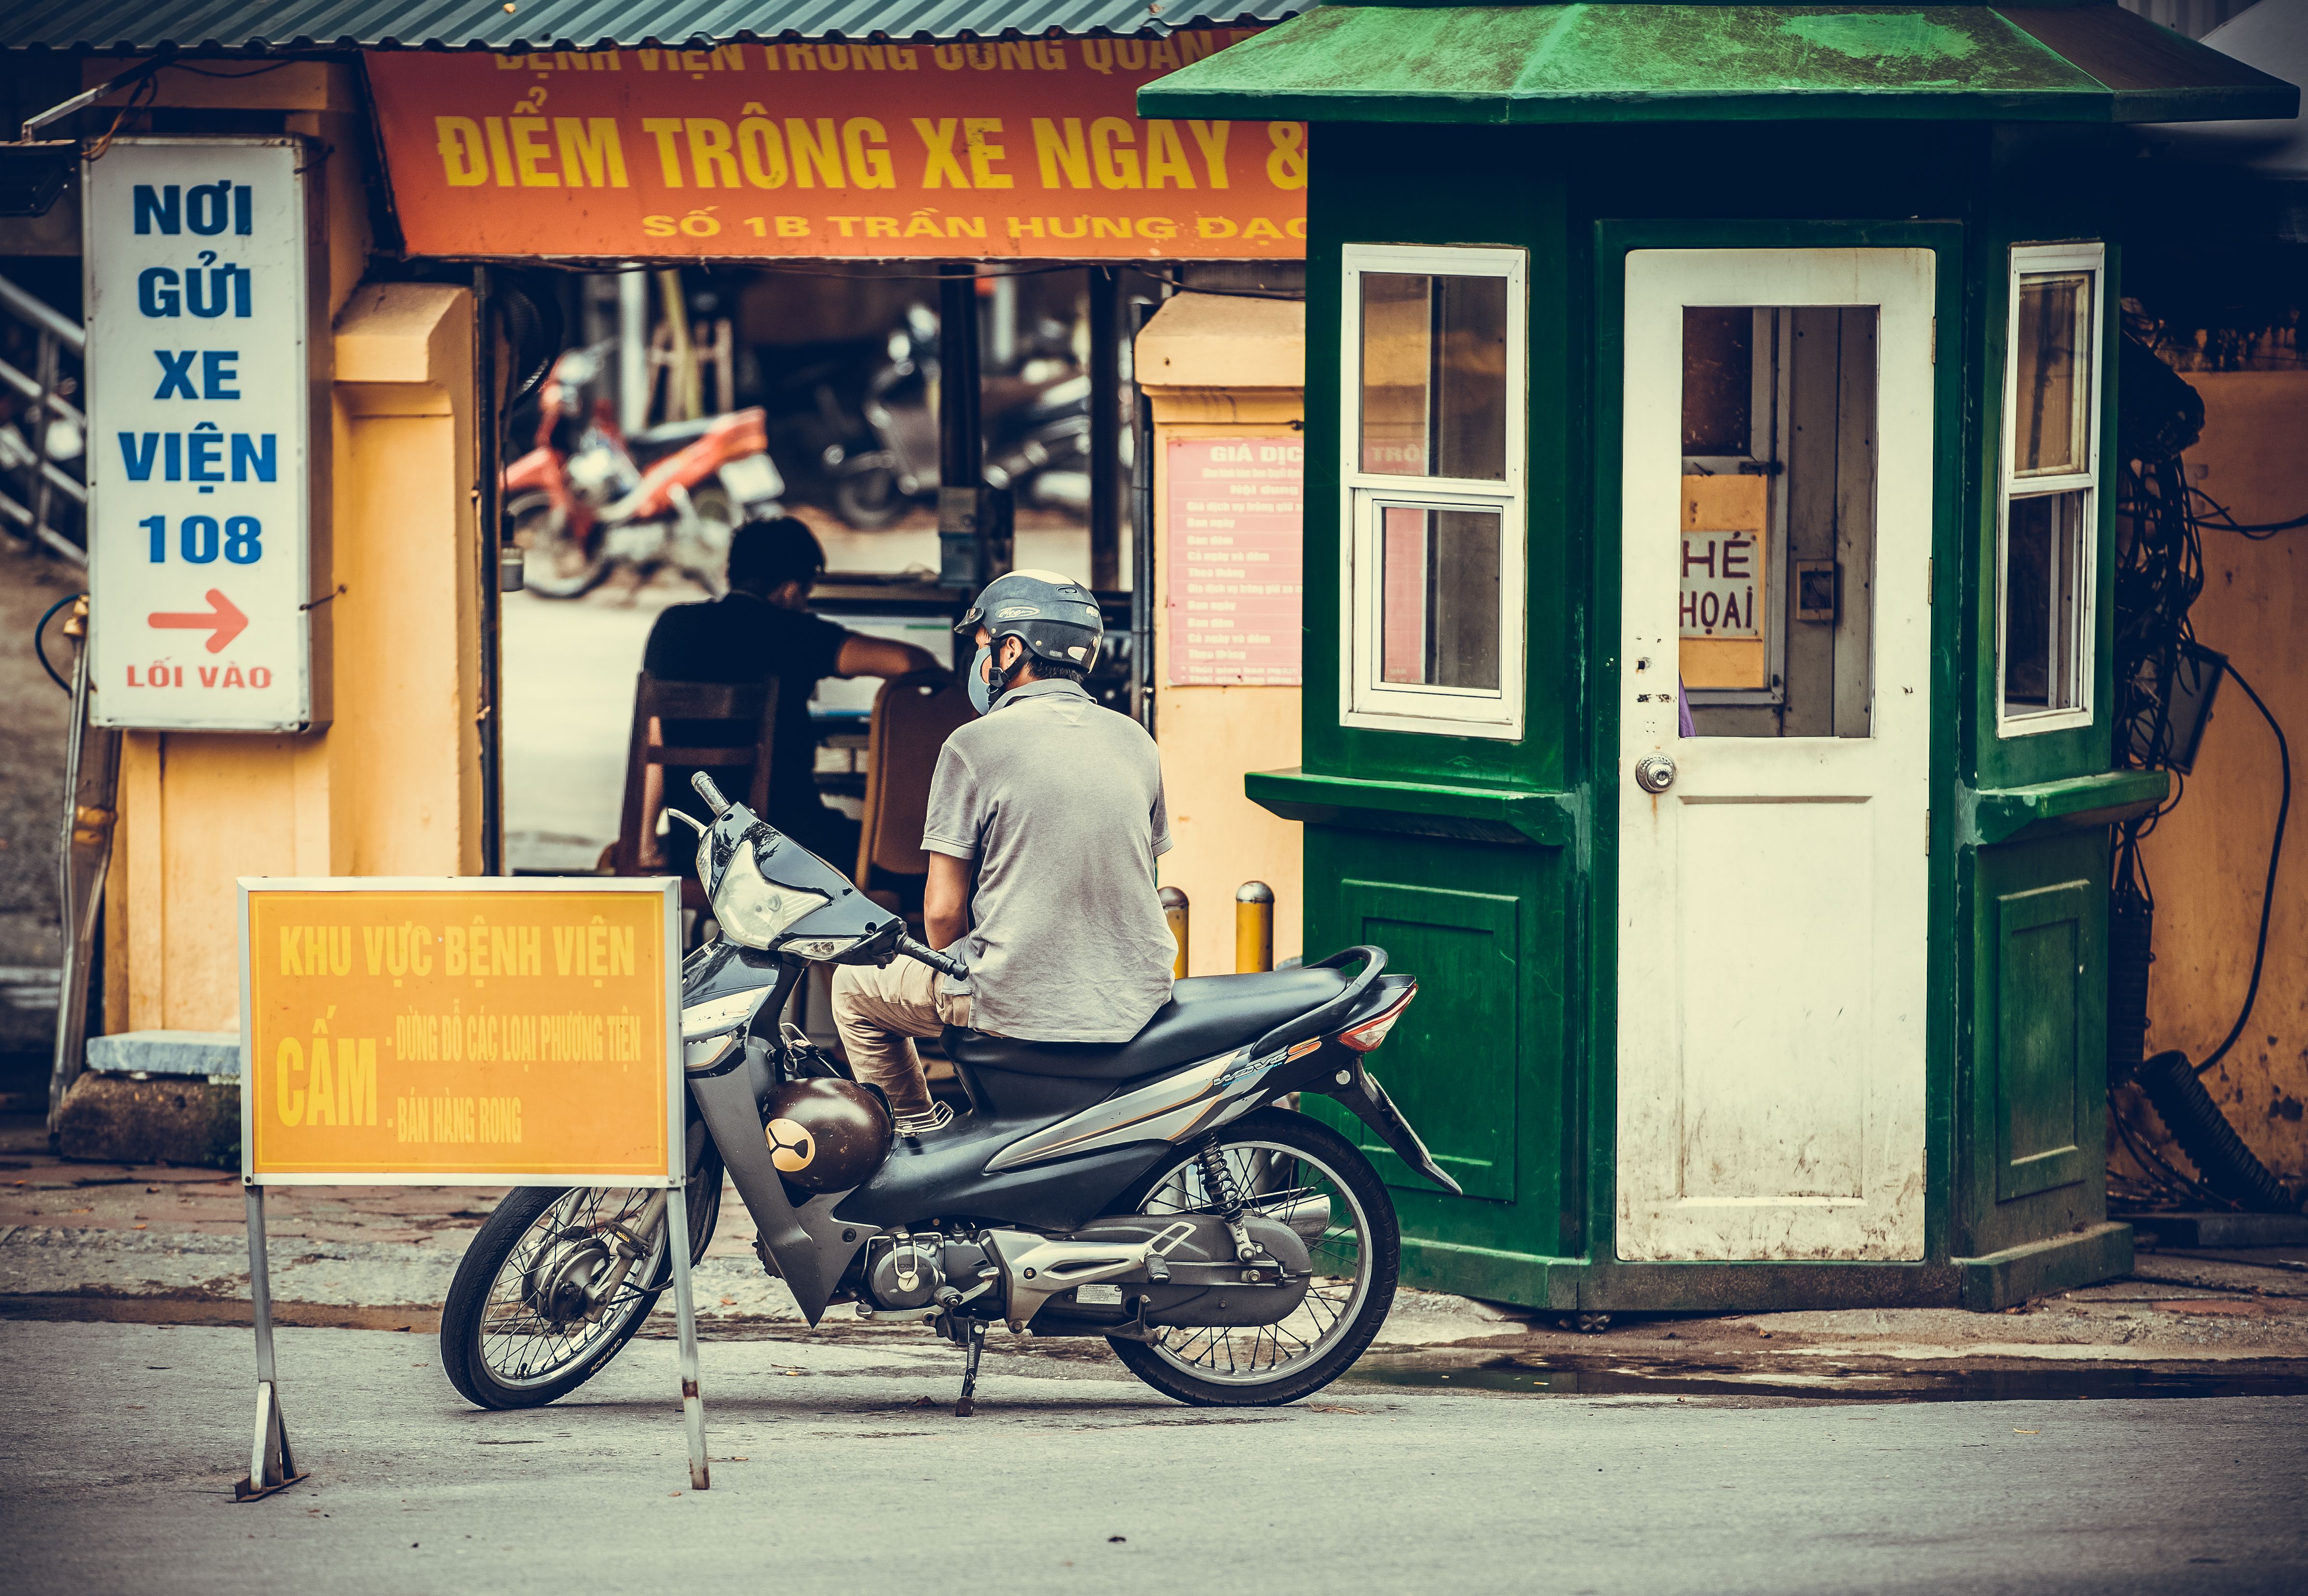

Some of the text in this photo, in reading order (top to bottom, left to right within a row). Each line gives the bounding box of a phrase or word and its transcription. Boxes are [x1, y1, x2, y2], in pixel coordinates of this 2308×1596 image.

[434, 86, 629, 188] ĐIỂM
[642, 102, 897, 189] TRÔNG
[911, 117, 1015, 189] XE
[133, 179, 252, 235] NƠI
[642, 206, 721, 237] SỐ
[743, 216, 811, 237] 1B
[825, 207, 988, 237] TRẦN
[1007, 215, 1177, 238] HƯNG
[138, 250, 252, 318] GỬI
[153, 350, 241, 400] XE
[117, 421, 277, 493] VIỆN
[1210, 443, 1254, 463] GIÁ
[1373, 443, 1425, 462] TRÔ
[139, 515, 262, 565] 108
[127, 657, 272, 688] LỐI VÀO
[279, 915, 635, 988] KHU VỰC BỆNH VIỆN
[396, 998, 641, 1072] DỪNG ĐỖ CÁC LOẠI PHƯƠNG TIỆN
[276, 1005, 377, 1127] CẤM
[397, 1087, 522, 1143] BÁN HÀNG RONG
[616, 1230, 631, 1243] HONDA
